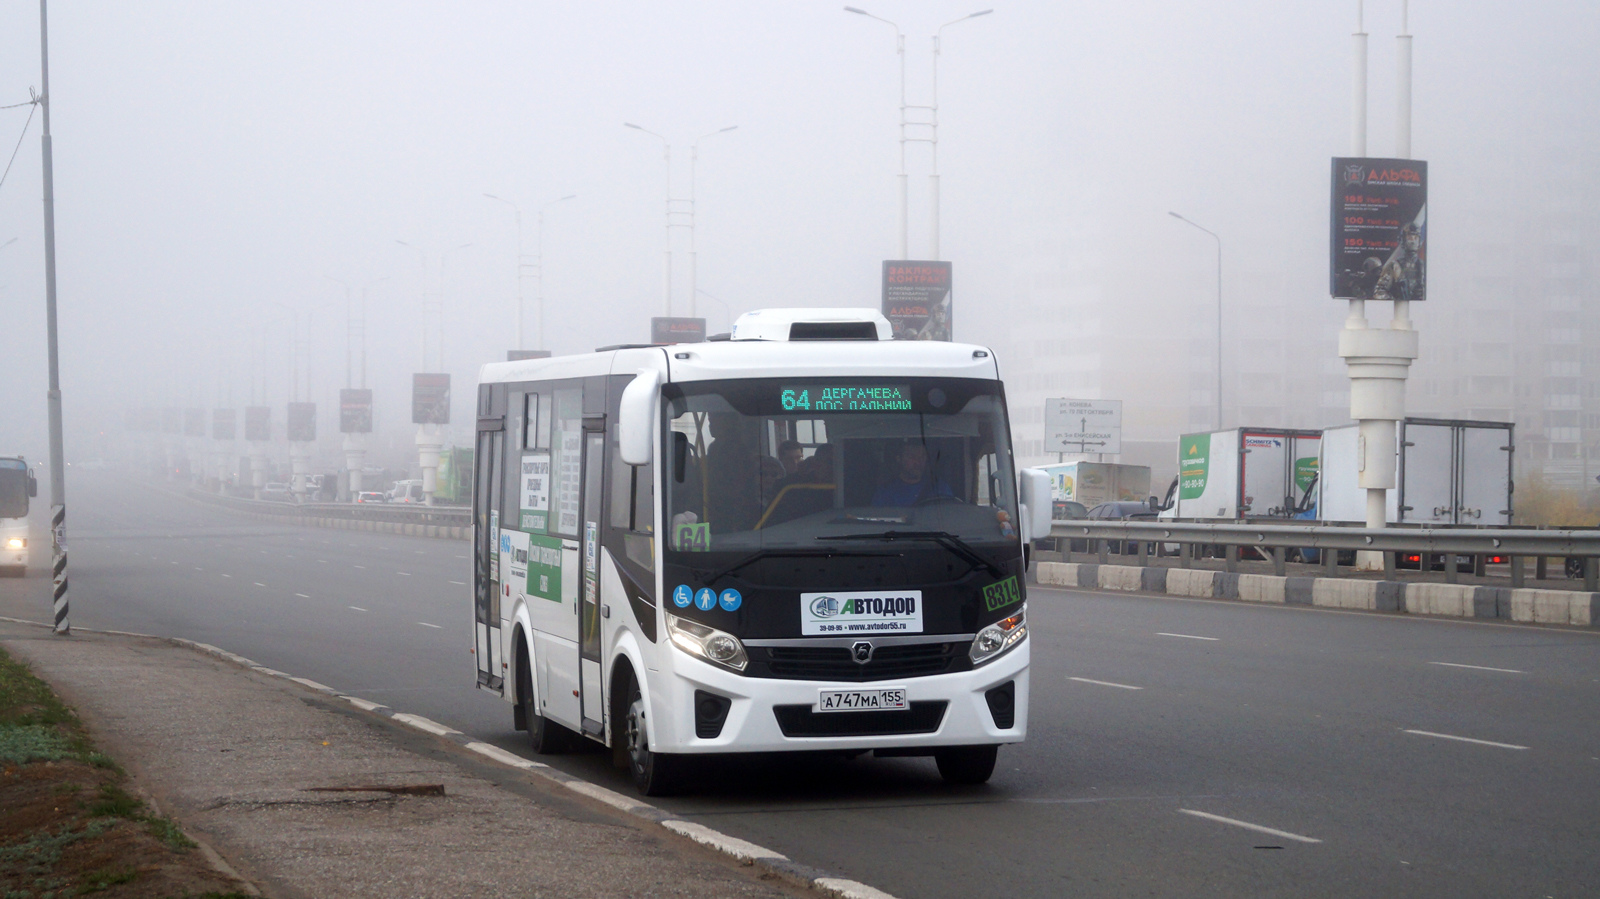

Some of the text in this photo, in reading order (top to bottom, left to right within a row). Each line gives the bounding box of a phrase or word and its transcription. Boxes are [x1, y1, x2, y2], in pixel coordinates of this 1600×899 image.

[1367, 168, 1421, 181] АЛЬФА
[1344, 216, 1364, 224] 100
[889, 266, 947, 275] ЗАКЛЮЧИ
[888, 275, 946, 283] КОНТРАКТ
[890, 306, 929, 315] АЛЬФА
[781, 389, 810, 410] 64
[822, 387, 901, 400] ДЕРГАЧЕВА
[680, 526, 707, 552] 64
[986, 578, 1019, 608] 8314
[848, 622, 906, 630] www.avtodor55.ru
[825, 691, 901, 708] А747МА 155
